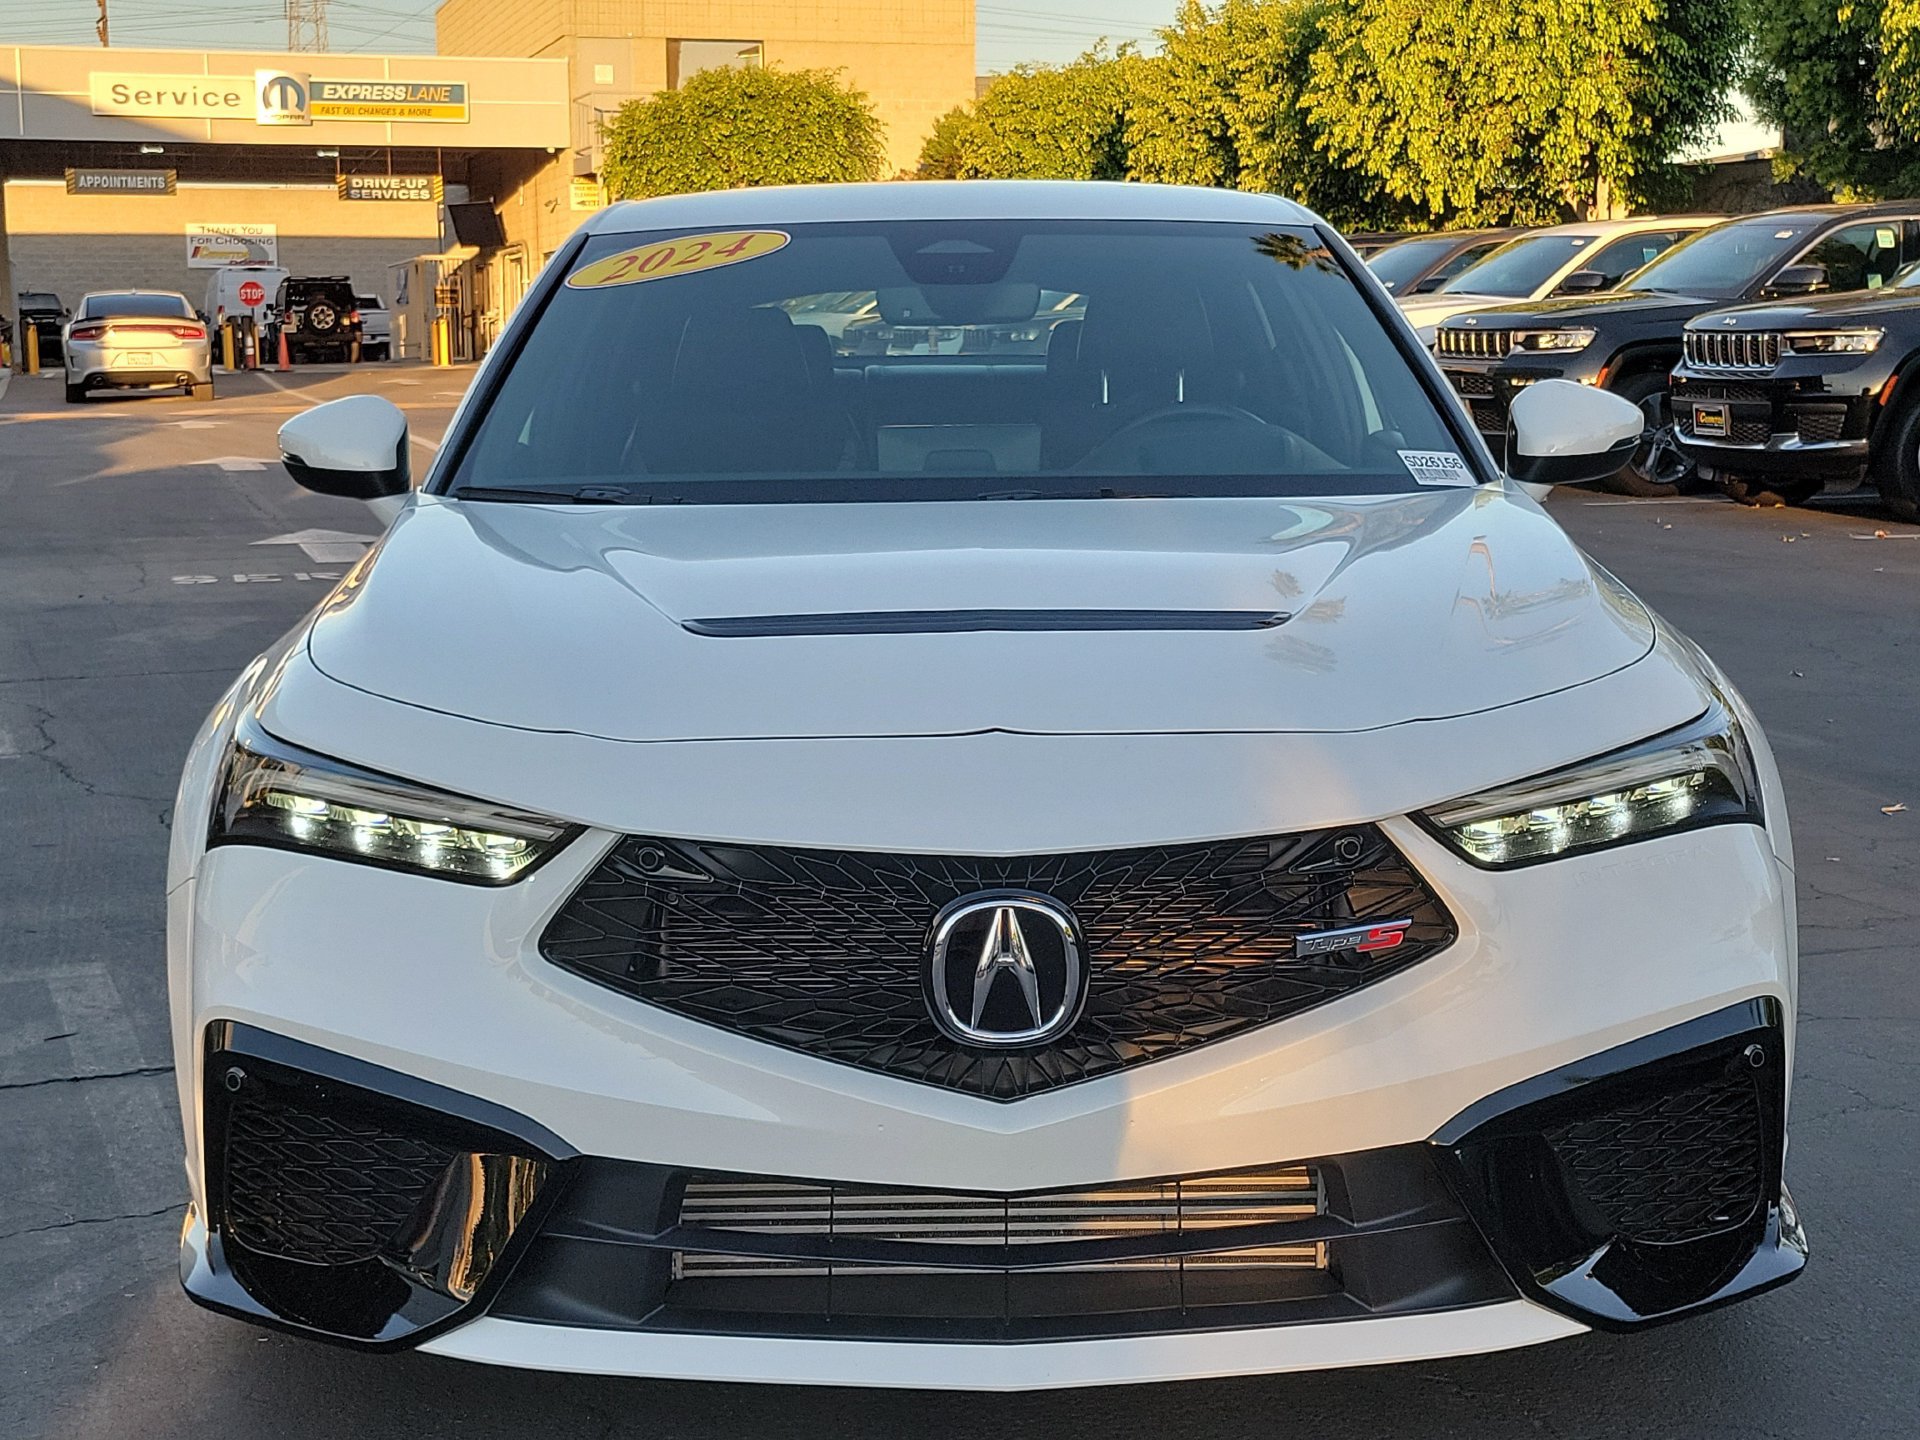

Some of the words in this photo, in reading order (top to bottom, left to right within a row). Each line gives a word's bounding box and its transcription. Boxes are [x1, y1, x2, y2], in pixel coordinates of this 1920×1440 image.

[111, 83, 241, 107] Service
[321, 106, 341, 115] FAST
[343, 107, 355, 115] OIL
[358, 107, 396, 116] CHANGES
[398, 108, 405, 116] &
[407, 108, 433, 117] MORE
[79, 175, 165, 189] APPOINTMENTS
[351, 178, 428, 189] DRIVE-UP
[350, 189, 431, 200] SERVICES
[199, 226, 237, 235] THANK
[241, 226, 263, 235] YOU
[190, 236, 213, 245] FOR
[215, 236, 274, 246] CHOOSING
[599, 234, 756, 284] 2024
[240, 288, 264, 300] STOP
[1404, 455, 1464, 470] SD26156
[1356, 922, 1412, 953] S
